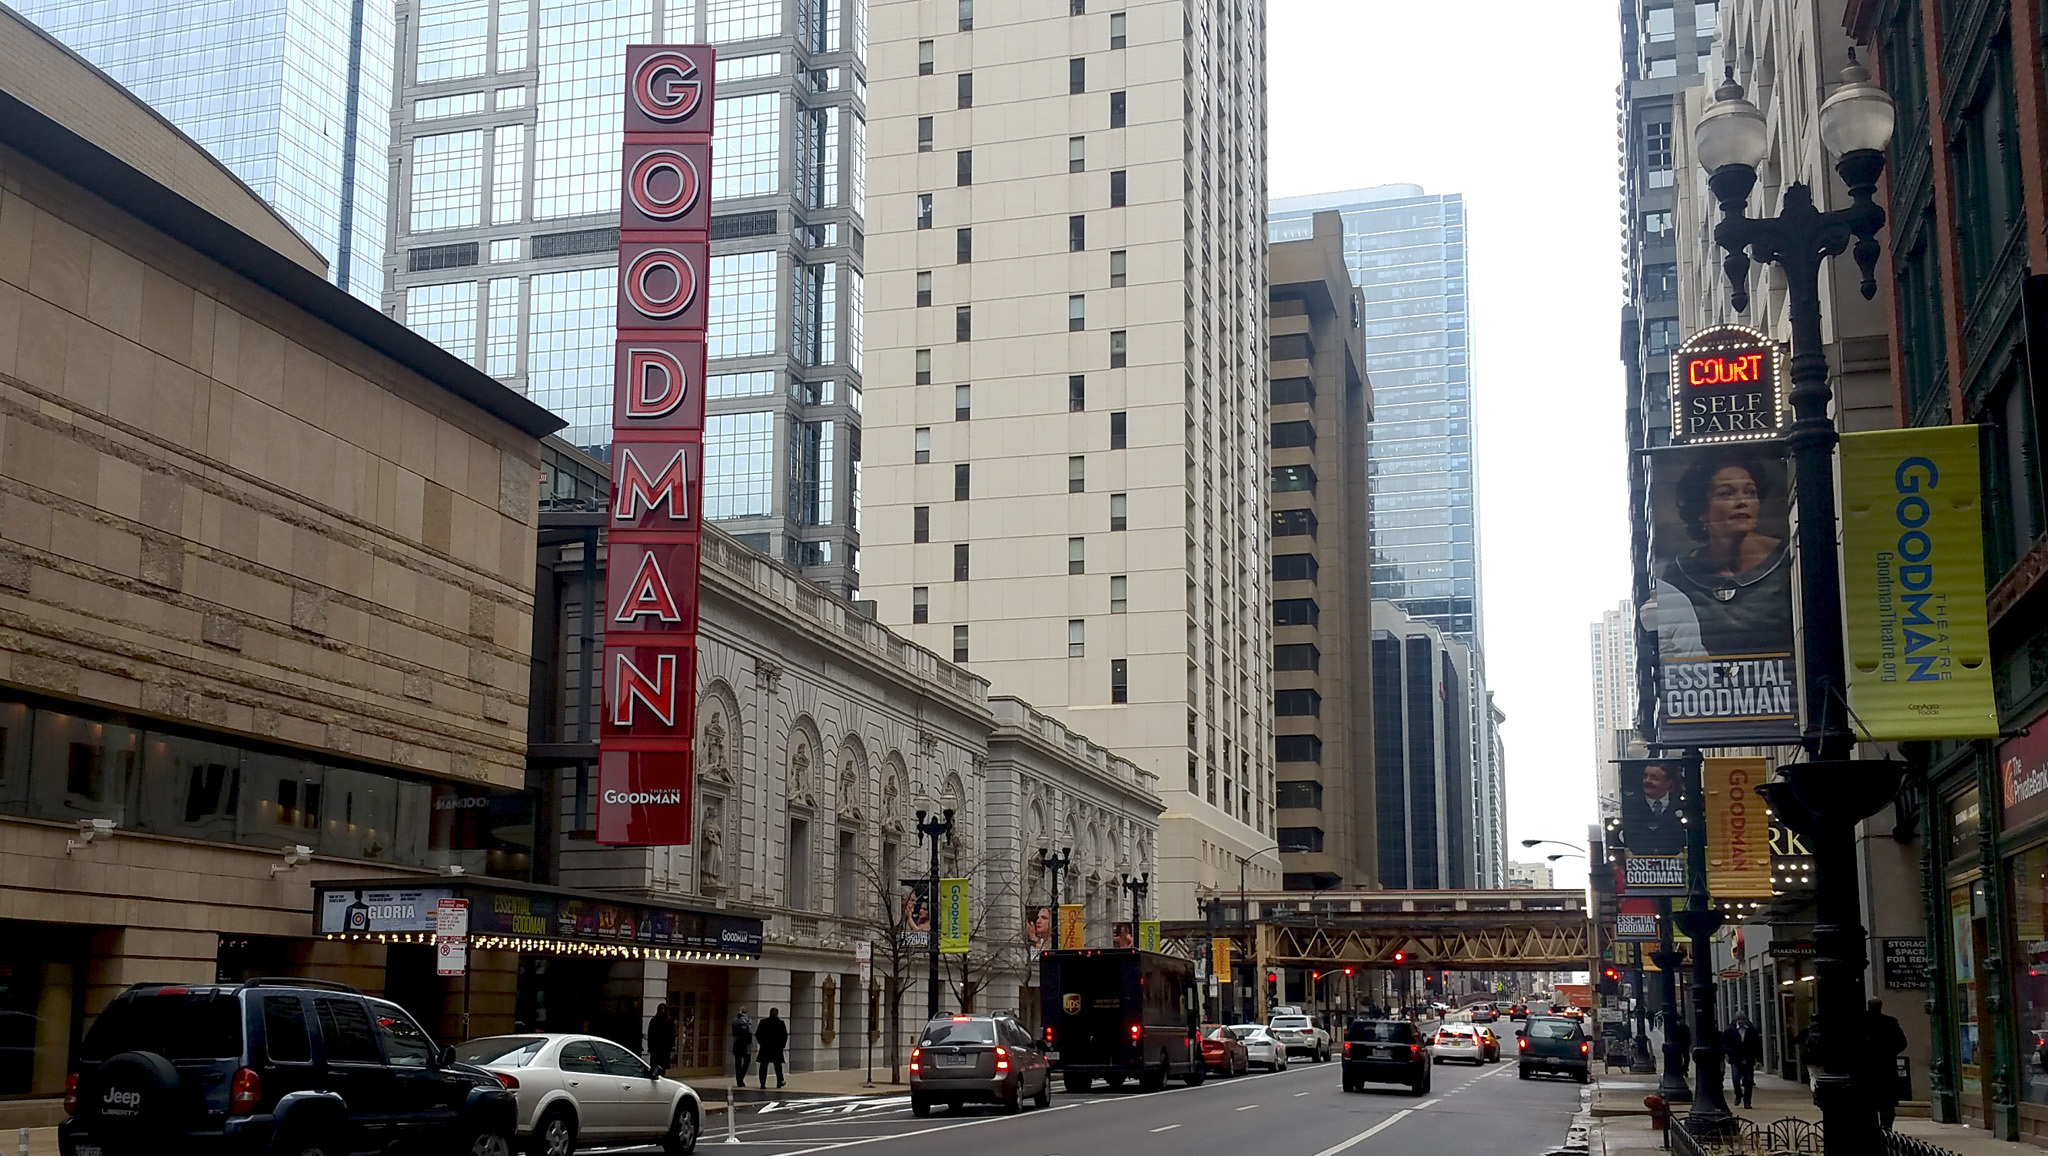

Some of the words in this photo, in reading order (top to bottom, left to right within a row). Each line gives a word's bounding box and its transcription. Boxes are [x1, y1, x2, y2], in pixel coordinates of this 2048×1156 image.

[1690, 354, 1762, 385] COURT
[614, 51, 701, 727] GOODMAN
[1693, 393, 1762, 415] SELF
[1689, 411, 1769, 434] PARK
[1895, 456, 1940, 682] GOODMAN
[1877, 552, 1897, 683] GoodmanTheatre.org
[1935, 593, 1952, 680] THEATRE
[1665, 660, 1791, 689] ESSENTIAL
[1667, 686, 1791, 717] GOODMAN
[2012, 756, 2021, 777] The
[2014, 763, 2047, 804] PrivateBank
[604, 789, 680, 804] GOODMAN
[1729, 769, 1748, 871] GOODMAN
[1626, 858, 1683, 871] ESSENTIAL
[1627, 871, 1682, 884] GOODMAN
[368, 905, 415, 919] GLORIA
[494, 894, 531, 914] ESSENTIAL
[951, 885, 960, 938] GOODMAN
[512, 914, 547, 934] GOODMAN
[1617, 915, 1656, 924] ESSENTIAL
[1618, 923, 1656, 933] GOODMAN
[721, 929, 748, 943] GOODMAN
[1065, 999, 1080, 1012] ups
[103, 1086, 141, 1108] Jeep
[101, 1108, 139, 1116] LIBERTY
